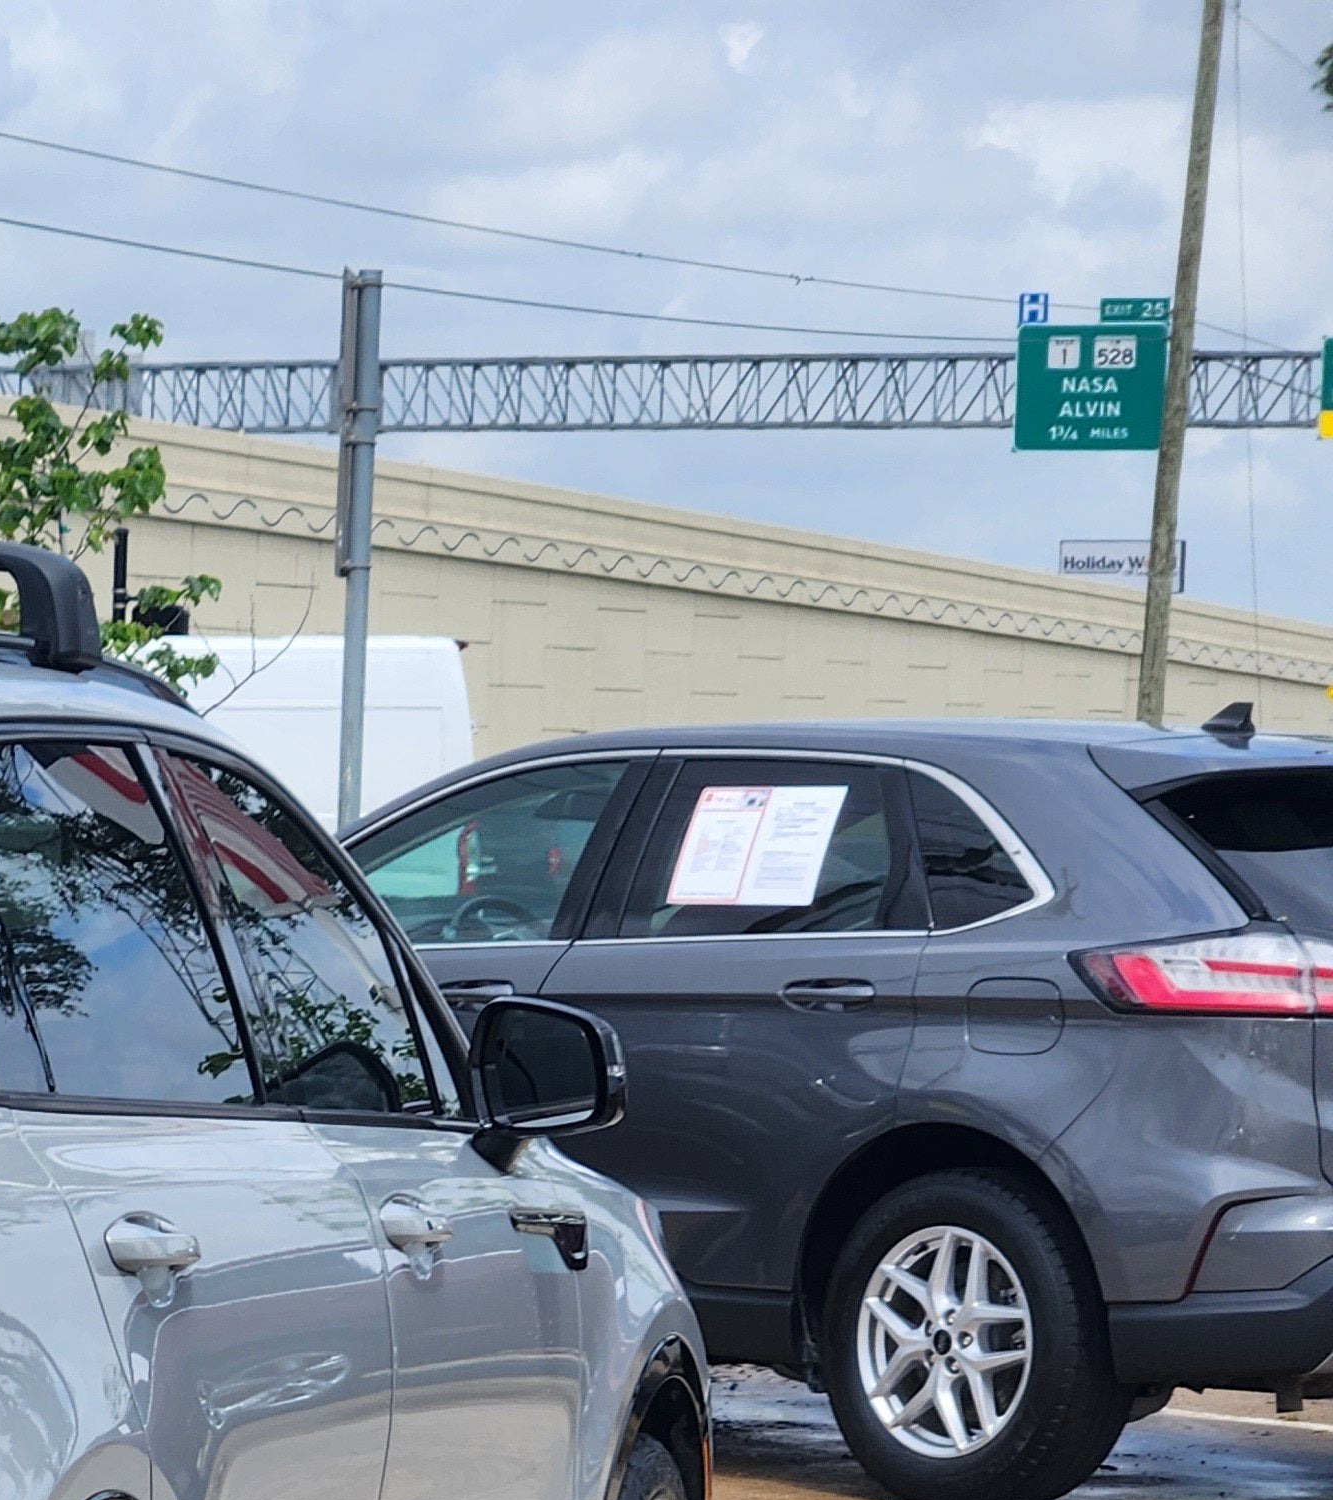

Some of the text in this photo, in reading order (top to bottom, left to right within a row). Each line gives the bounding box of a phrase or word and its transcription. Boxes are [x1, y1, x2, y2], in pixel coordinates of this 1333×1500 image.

[1141, 302, 1165, 318] 25
[1097, 348, 1133, 366] 528
[1061, 376, 1118, 393] NASA
[1059, 400, 1121, 418] ALVIN
[1089, 427, 1129, 439] MILES
[1063, 555, 1125, 570] Holiday
